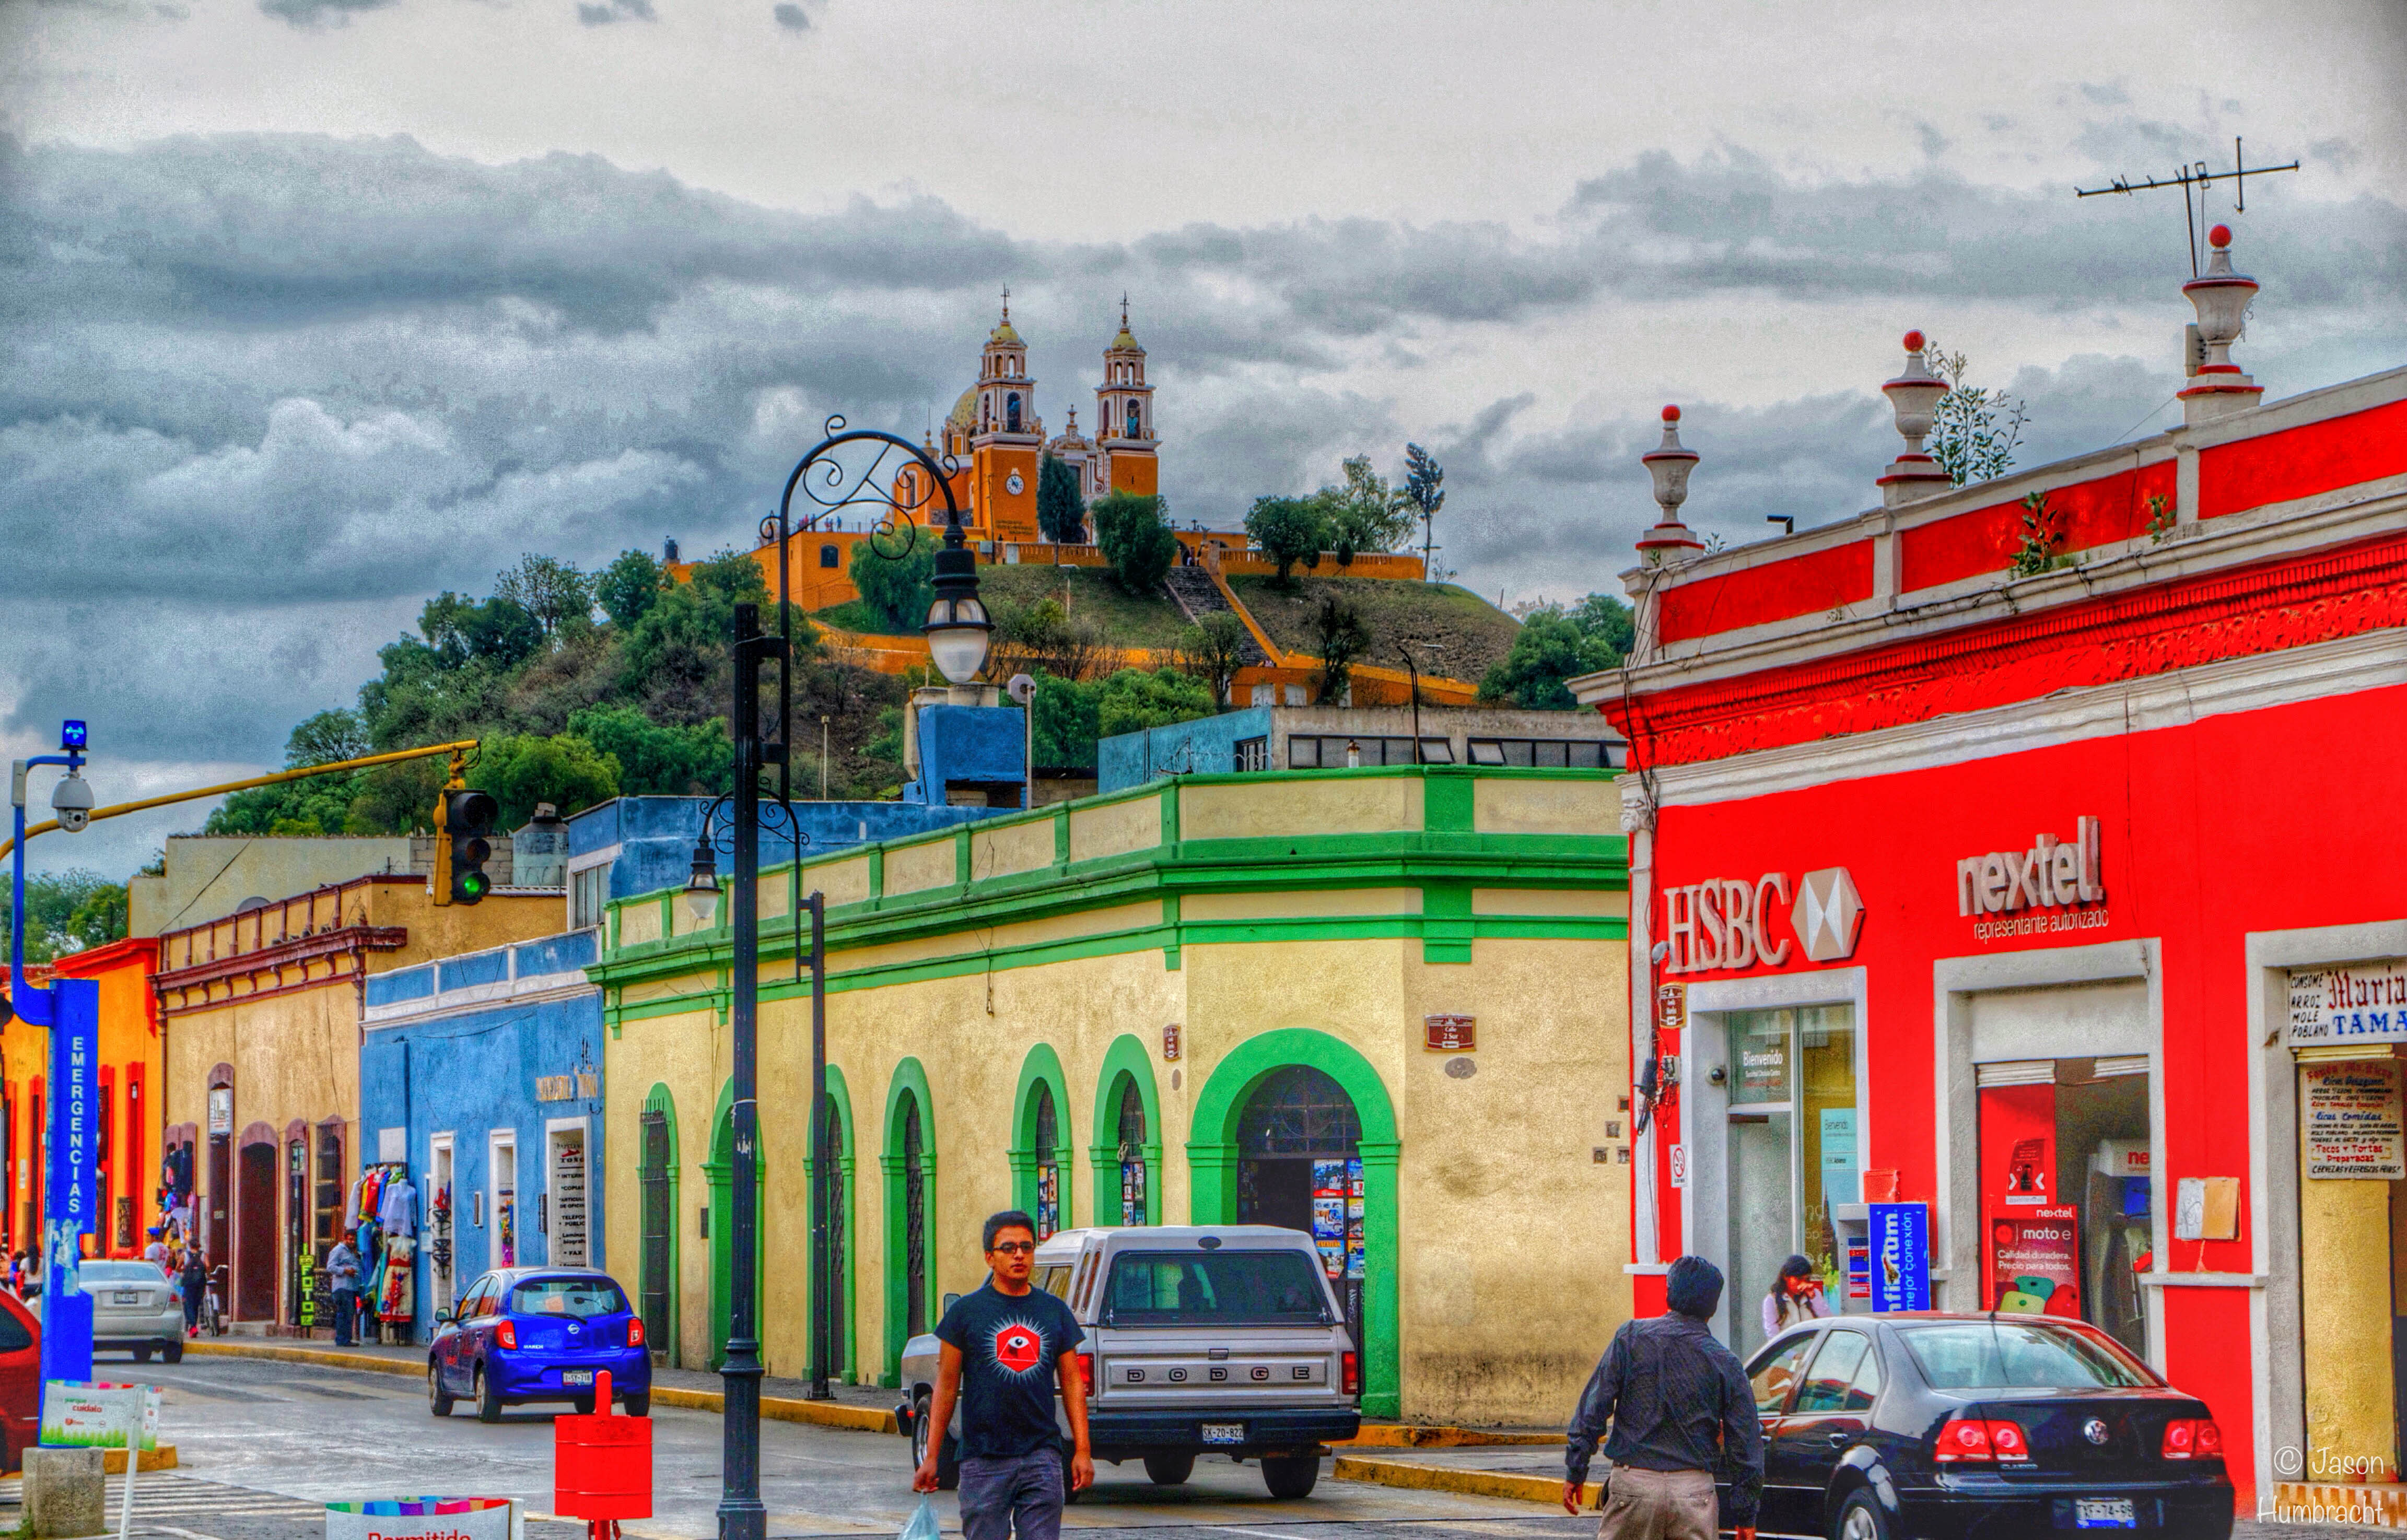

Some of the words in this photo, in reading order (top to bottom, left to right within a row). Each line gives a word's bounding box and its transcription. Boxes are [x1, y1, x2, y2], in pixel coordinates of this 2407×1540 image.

[1957, 815, 2104, 917] nextel
[1663, 872, 1792, 974] HSBC
[1973, 913, 2048, 944] representante
[2050, 908, 2109, 933] autorizado
[2291, 973, 2323, 989] CONSOME
[2291, 995, 2321, 1009] ARROZ
[2293, 1010, 2319, 1023] MOLE
[2292, 1025, 2329, 1038] POBLANO
[1743, 1050, 1783, 1066] Bienvenido
[2342, 1111, 2382, 1120] Comidas
[68, 1036, 85, 1213] EMERGENCIAS
[2352, 1145, 2382, 1153] Tortas
[2036, 1207, 2073, 1218] nextel
[1901, 1212, 1914, 1271] conexión
[2023, 1227, 2059, 1240] moto
[2062, 1229, 2072, 1240] e
[1997, 1250, 2030, 1260] Calidad
[2031, 1250, 2072, 1260] duradera.
[1999, 1261, 2024, 1271] Precio
[2025, 1262, 2043, 1272] para
[2044, 1262, 2072, 1271] todos.
[301, 1265, 314, 1312] FOTO
[1904, 1274, 1917, 1311] mejor
[1127, 1366, 1310, 1382] DODGE
